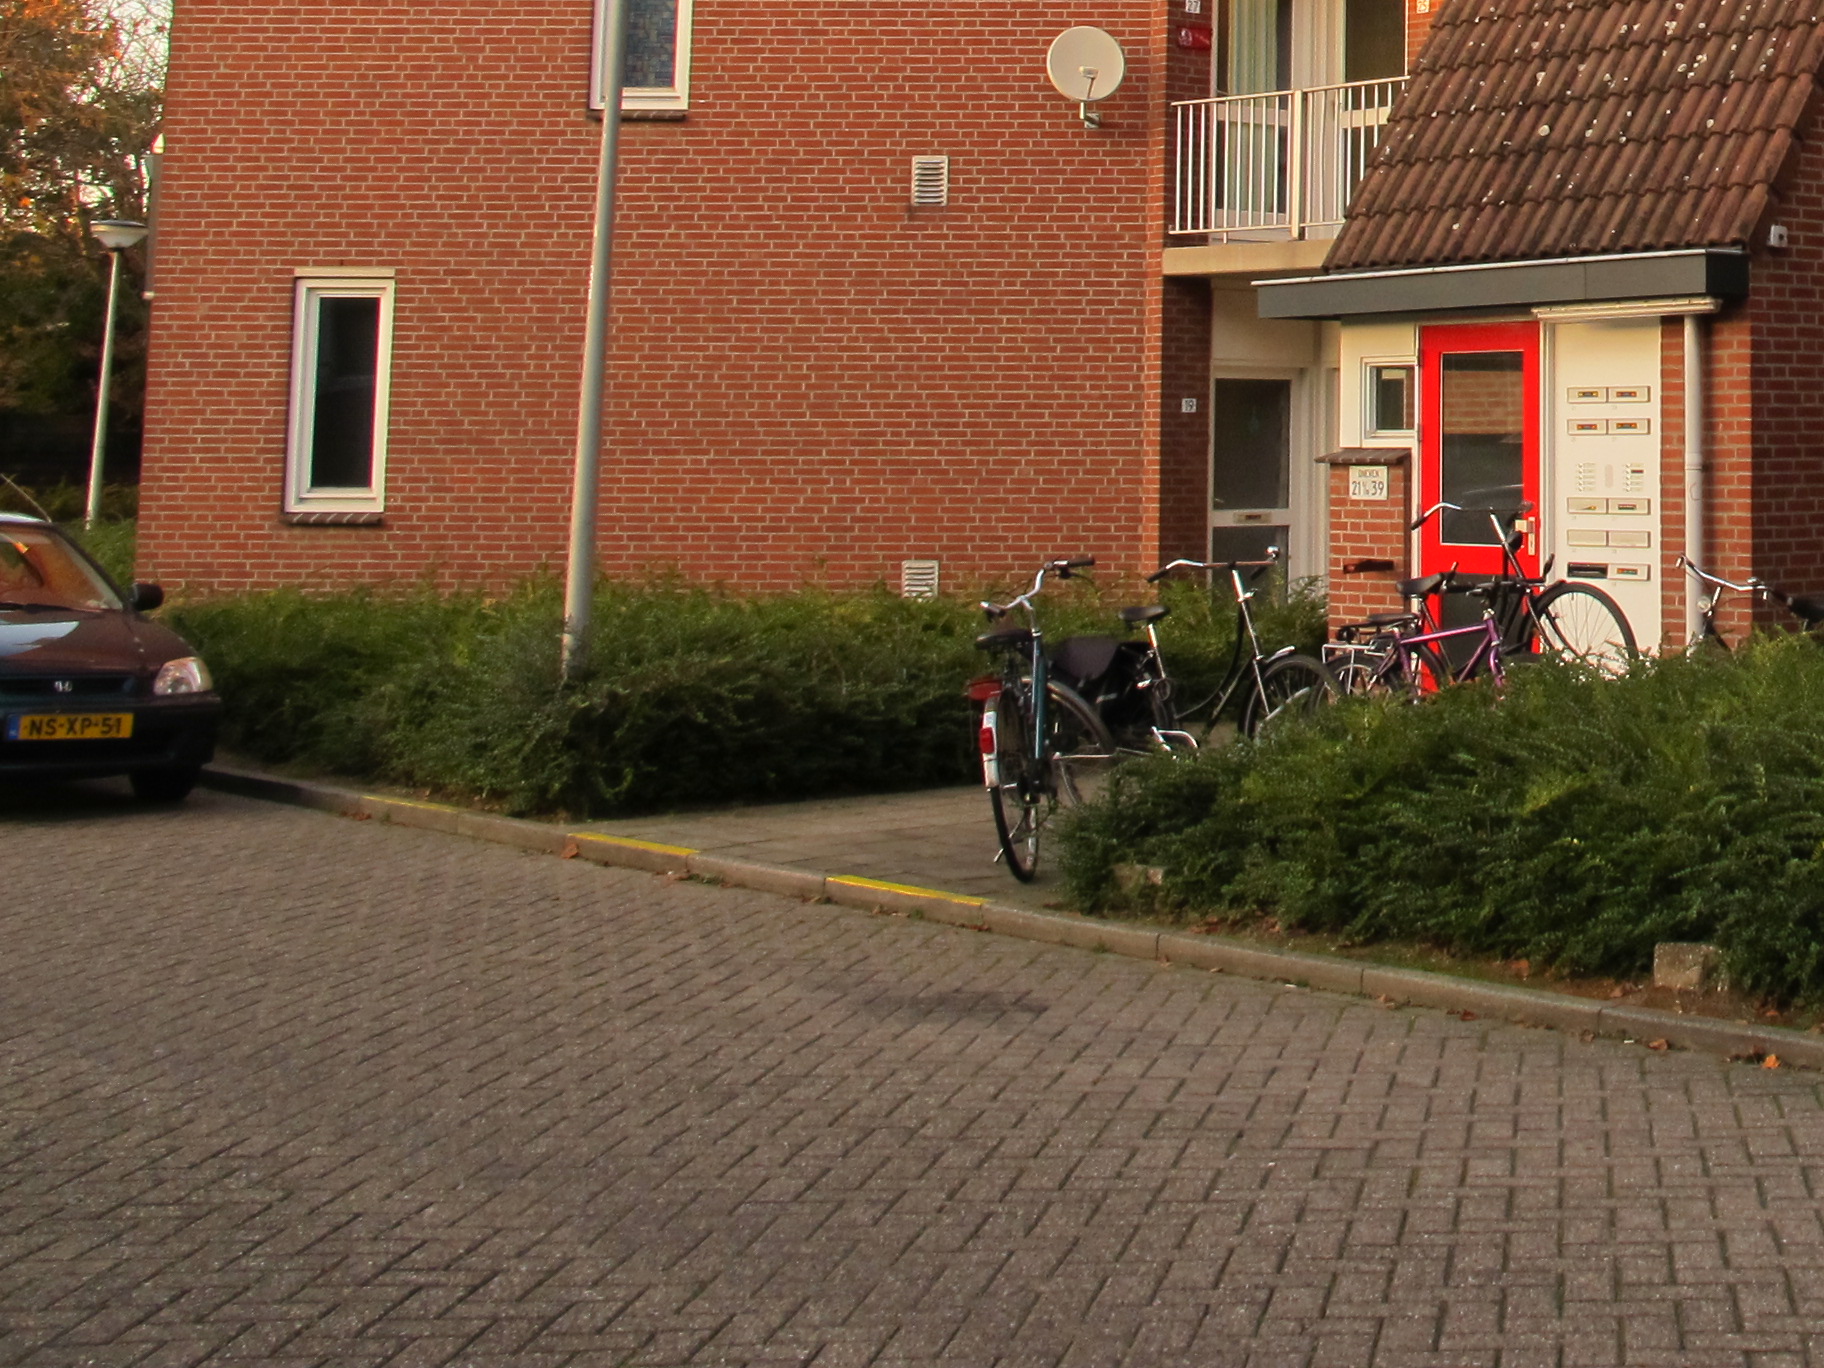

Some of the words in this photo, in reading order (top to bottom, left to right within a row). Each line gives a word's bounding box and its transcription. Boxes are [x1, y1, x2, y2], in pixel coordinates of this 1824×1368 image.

[1351, 480, 1361, 496] 21
[1371, 480, 1384, 496] 39
[29, 717, 122, 736] NS-XP-51
